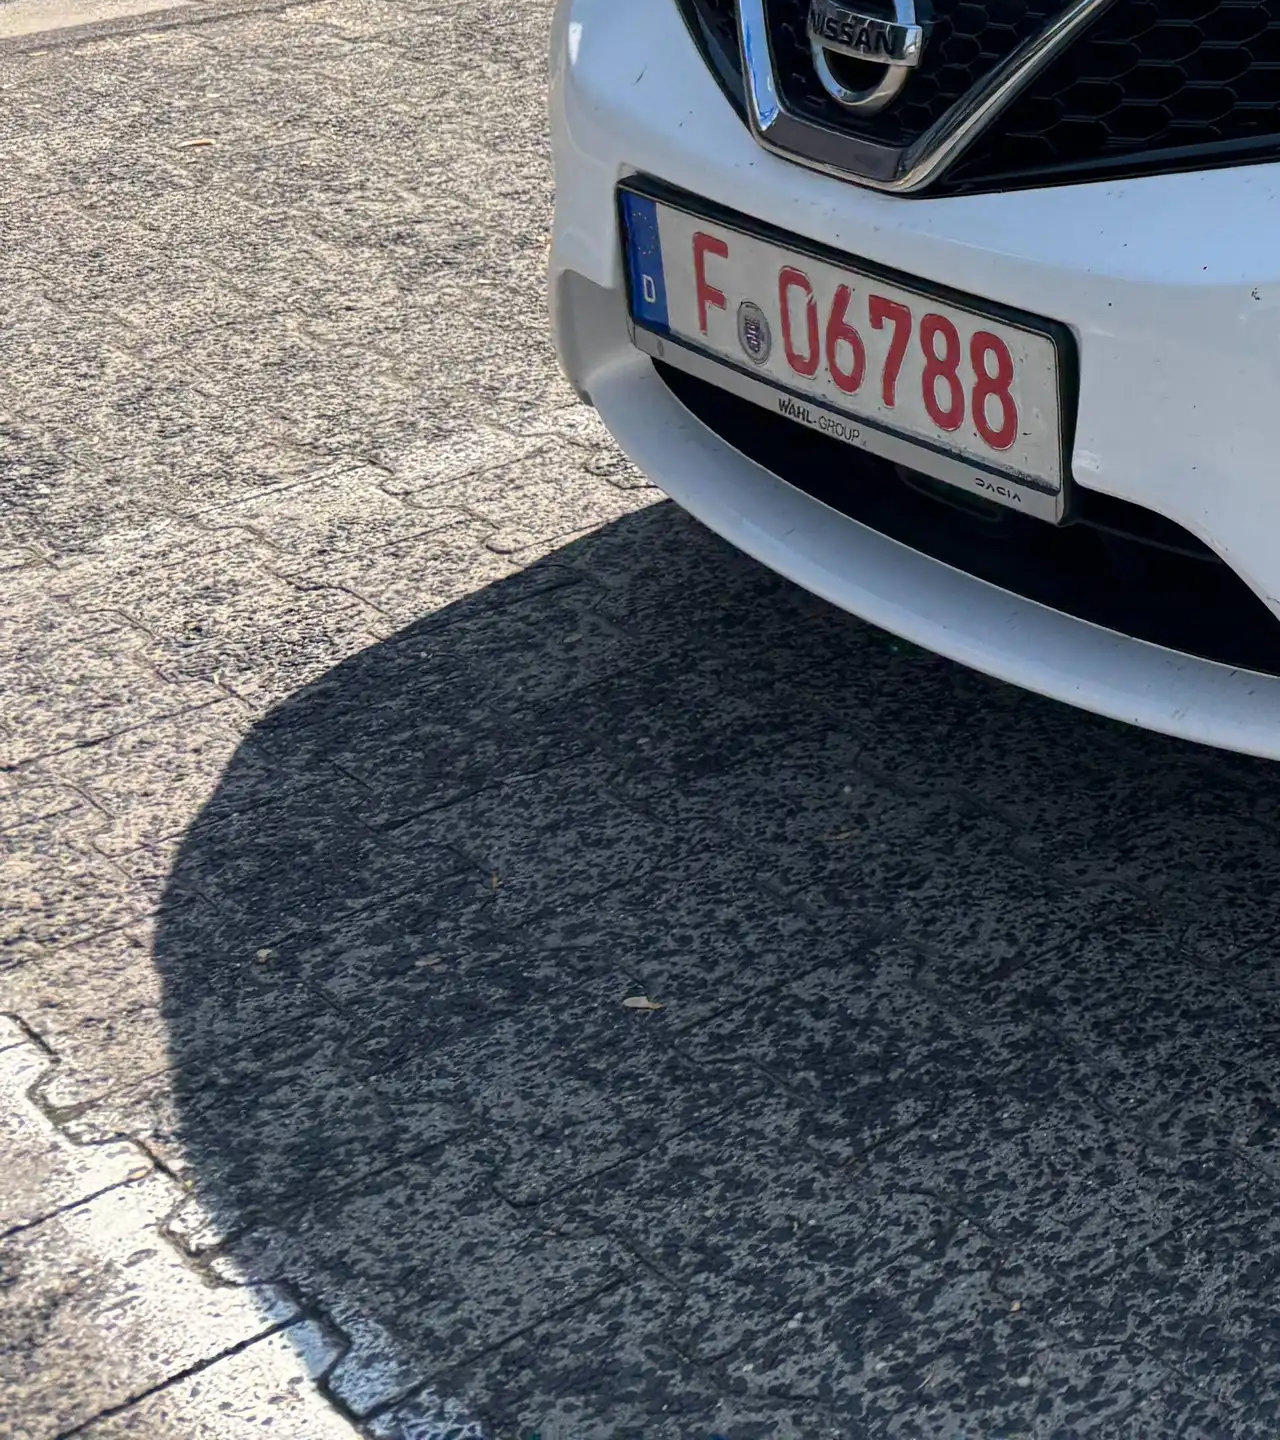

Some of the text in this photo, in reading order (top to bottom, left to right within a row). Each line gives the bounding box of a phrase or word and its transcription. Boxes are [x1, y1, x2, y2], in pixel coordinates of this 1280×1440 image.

[808, 10, 896, 56] NISSAN
[642, 274, 657, 304] D
[693, 231, 1020, 452] F 06788
[975, 477, 1022, 503] DACIA
